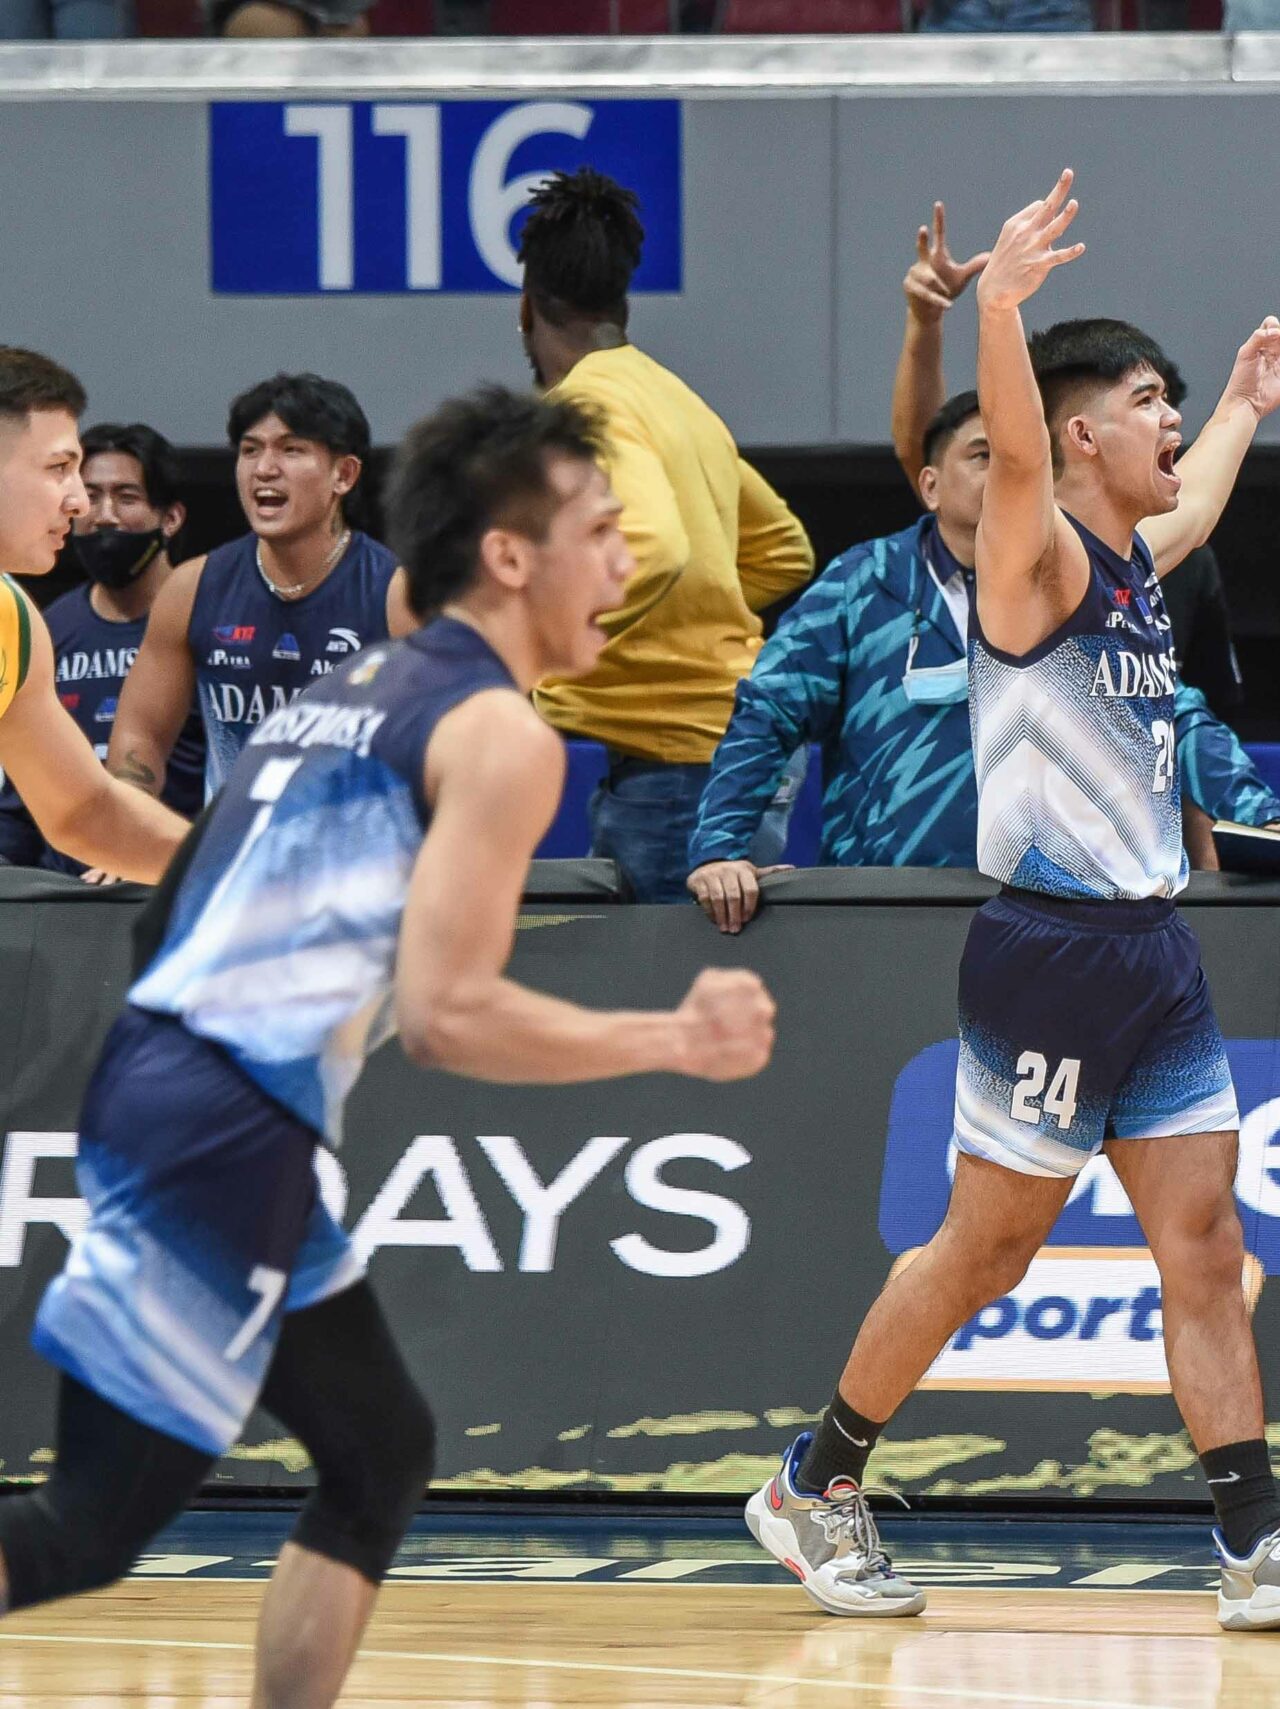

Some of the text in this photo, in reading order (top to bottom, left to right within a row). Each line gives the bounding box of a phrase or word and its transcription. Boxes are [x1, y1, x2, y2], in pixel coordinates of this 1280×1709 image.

[283, 102, 594, 291] 116
[1009, 1050, 1081, 1130] 24
[0, 1131, 752, 1278] RAYS
[223, 1264, 287, 1361] 7
[952, 1286, 1163, 1350] port
